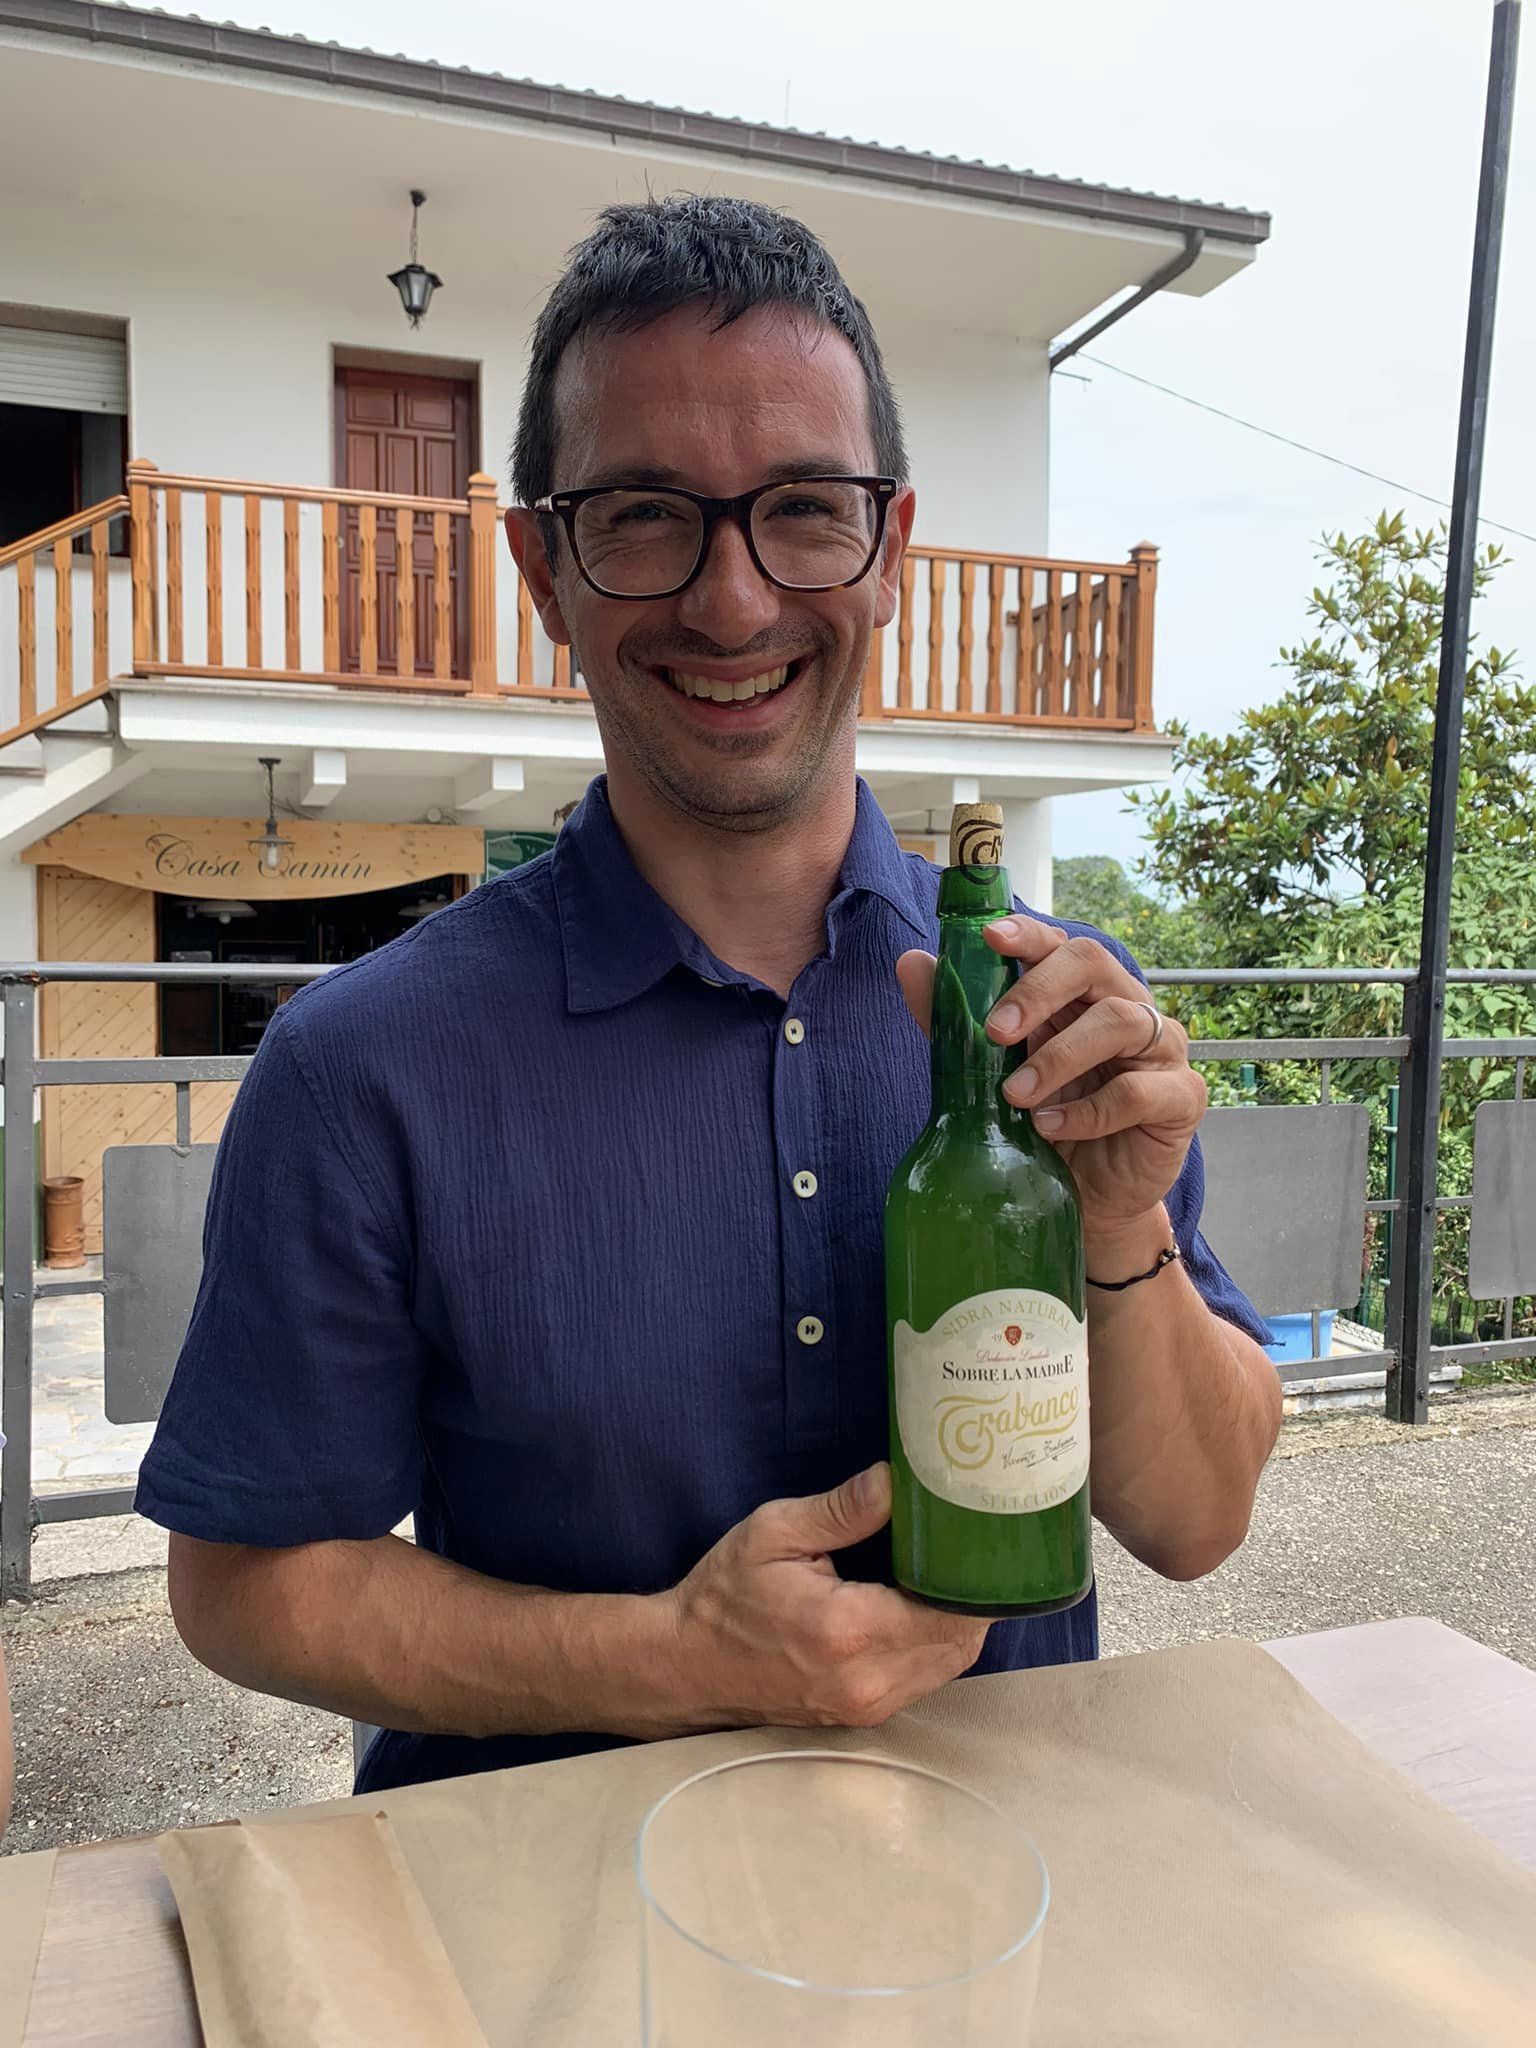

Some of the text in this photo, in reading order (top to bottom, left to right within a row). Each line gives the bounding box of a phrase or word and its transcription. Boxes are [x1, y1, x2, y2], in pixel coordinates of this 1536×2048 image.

[146, 833, 240, 878] Casa
[943, 1299, 1071, 1338] SIDRA NATURAL
[1003, 1367, 1022, 1380] LA
[1025, 1354, 1074, 1379] MADRE
[934, 1384, 1079, 1470] Trabanco
